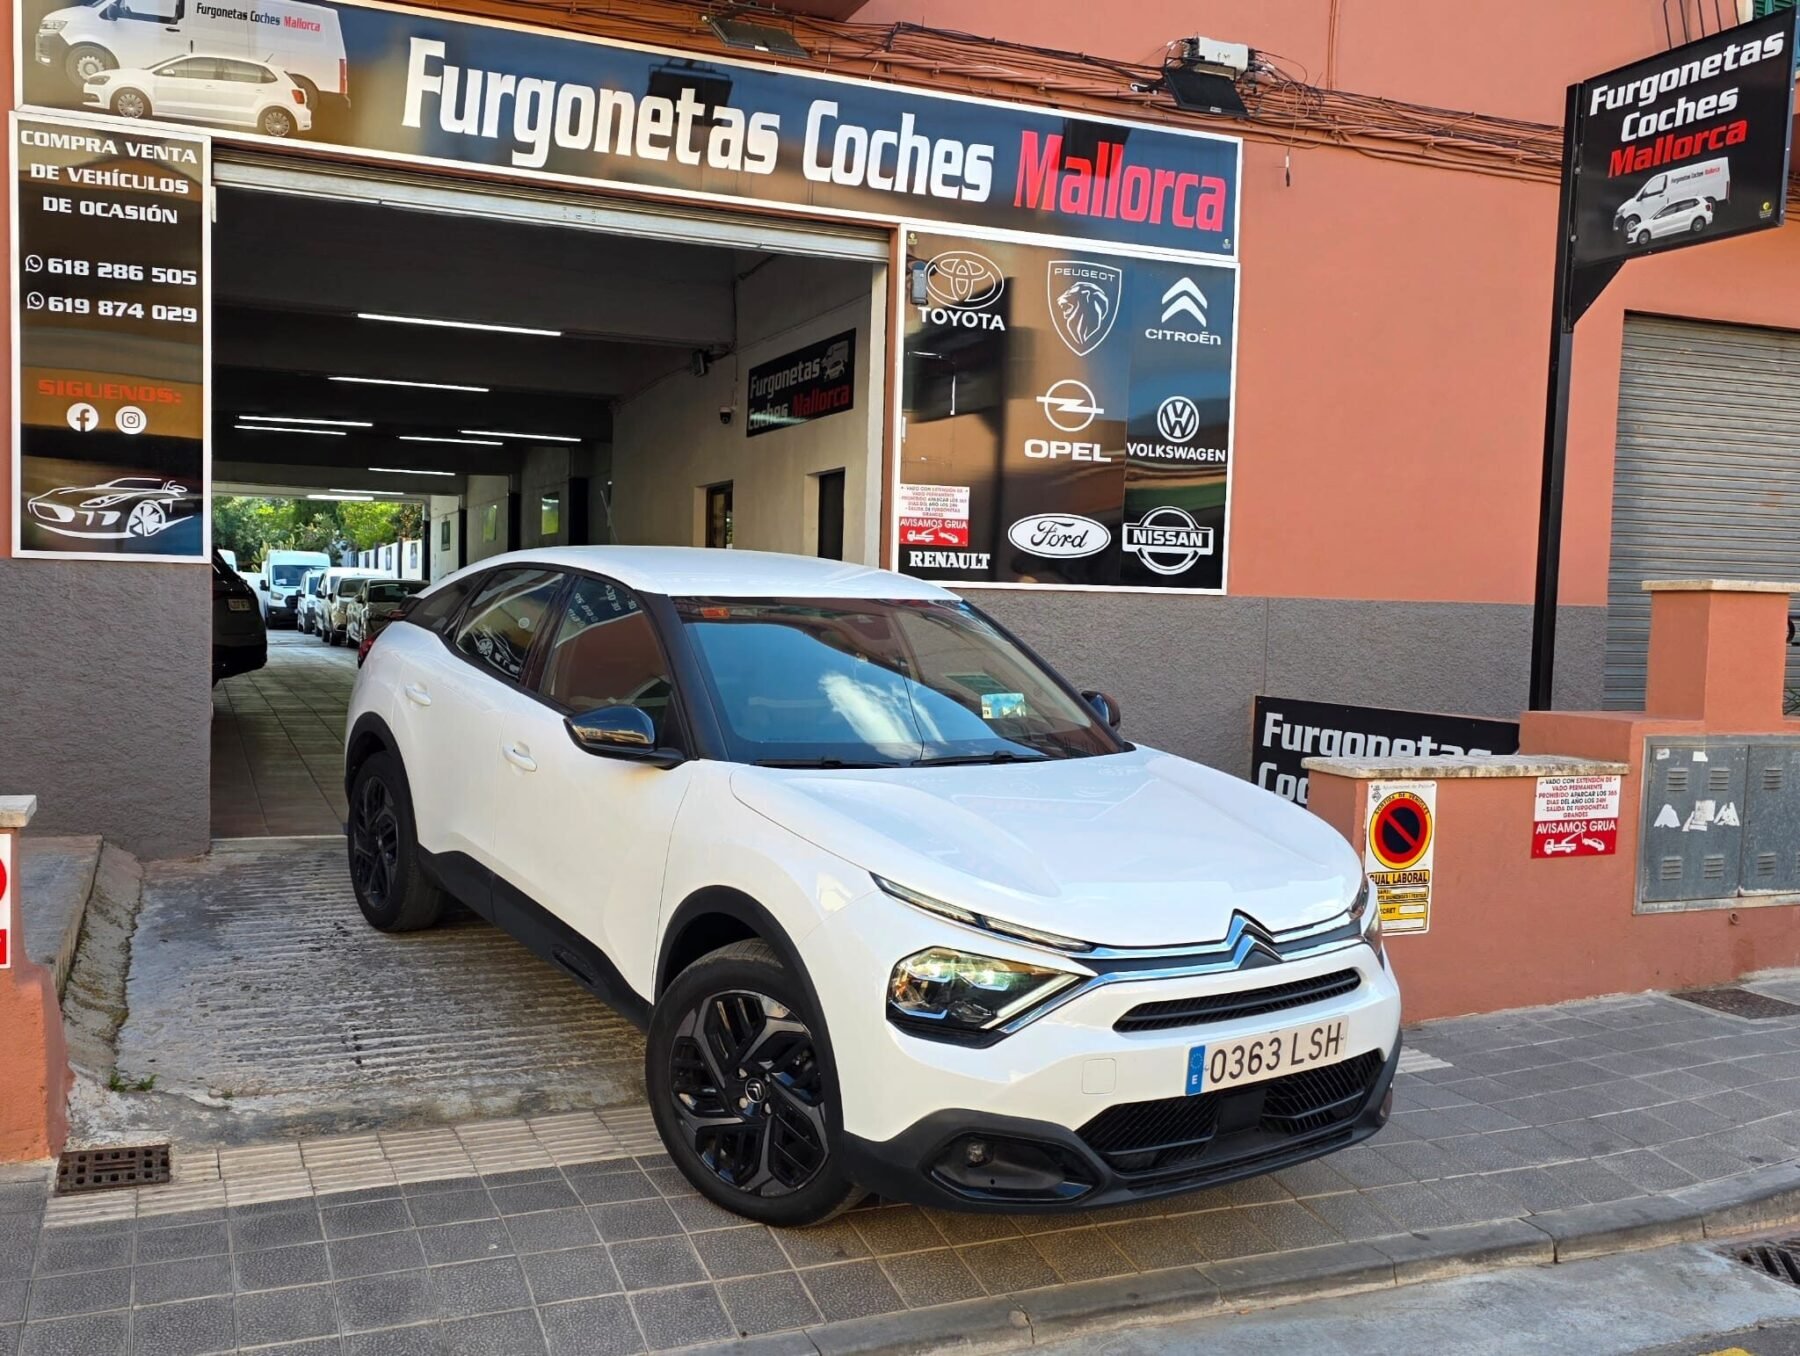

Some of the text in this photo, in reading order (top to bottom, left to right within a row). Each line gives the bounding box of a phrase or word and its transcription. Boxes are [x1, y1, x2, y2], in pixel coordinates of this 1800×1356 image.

[196, 3, 320, 32] Furgonetas Coches Mallorca
[1590, 32, 1784, 116] Furgonetas
[1621, 87, 1739, 142] Coches
[21, 130, 197, 164] COMPRA VENTA
[402, 37, 1226, 232] Furgonetas Coches Mallorca
[1608, 120, 1747, 178] Mallorca
[31, 163, 189, 194] DE VEHÍCULOS
[43, 197, 177, 224] DE OCASIÓN
[48, 258, 197, 286] 618 286 505
[1054, 267, 1116, 282] PEUGEOT
[49, 297, 197, 322] 619 874 029
[918, 306, 1005, 331] TOYOTA
[39, 379, 183, 403] SIGUENOS:
[750, 358, 820, 399] Furgonetas
[748, 384, 850, 431] Coches Mallorca
[1025, 439, 1111, 462] OPEL
[1127, 443, 1226, 462] VOLKSWAGEN
[900, 518, 968, 529] AVISAMOS GRUA
[1030, 521, 1089, 549] Ford
[1133, 529, 1203, 547] NISSAN
[909, 551, 990, 570] RENAULT
[1262, 712, 1492, 757] Furgonet
[1536, 820, 1616, 834] AVISAMOS GRUA
[1393, 872, 1428, 884] LABORAL
[1210, 1022, 1342, 1084] 0363 LSH
[1192, 1074, 1198, 1085] E
